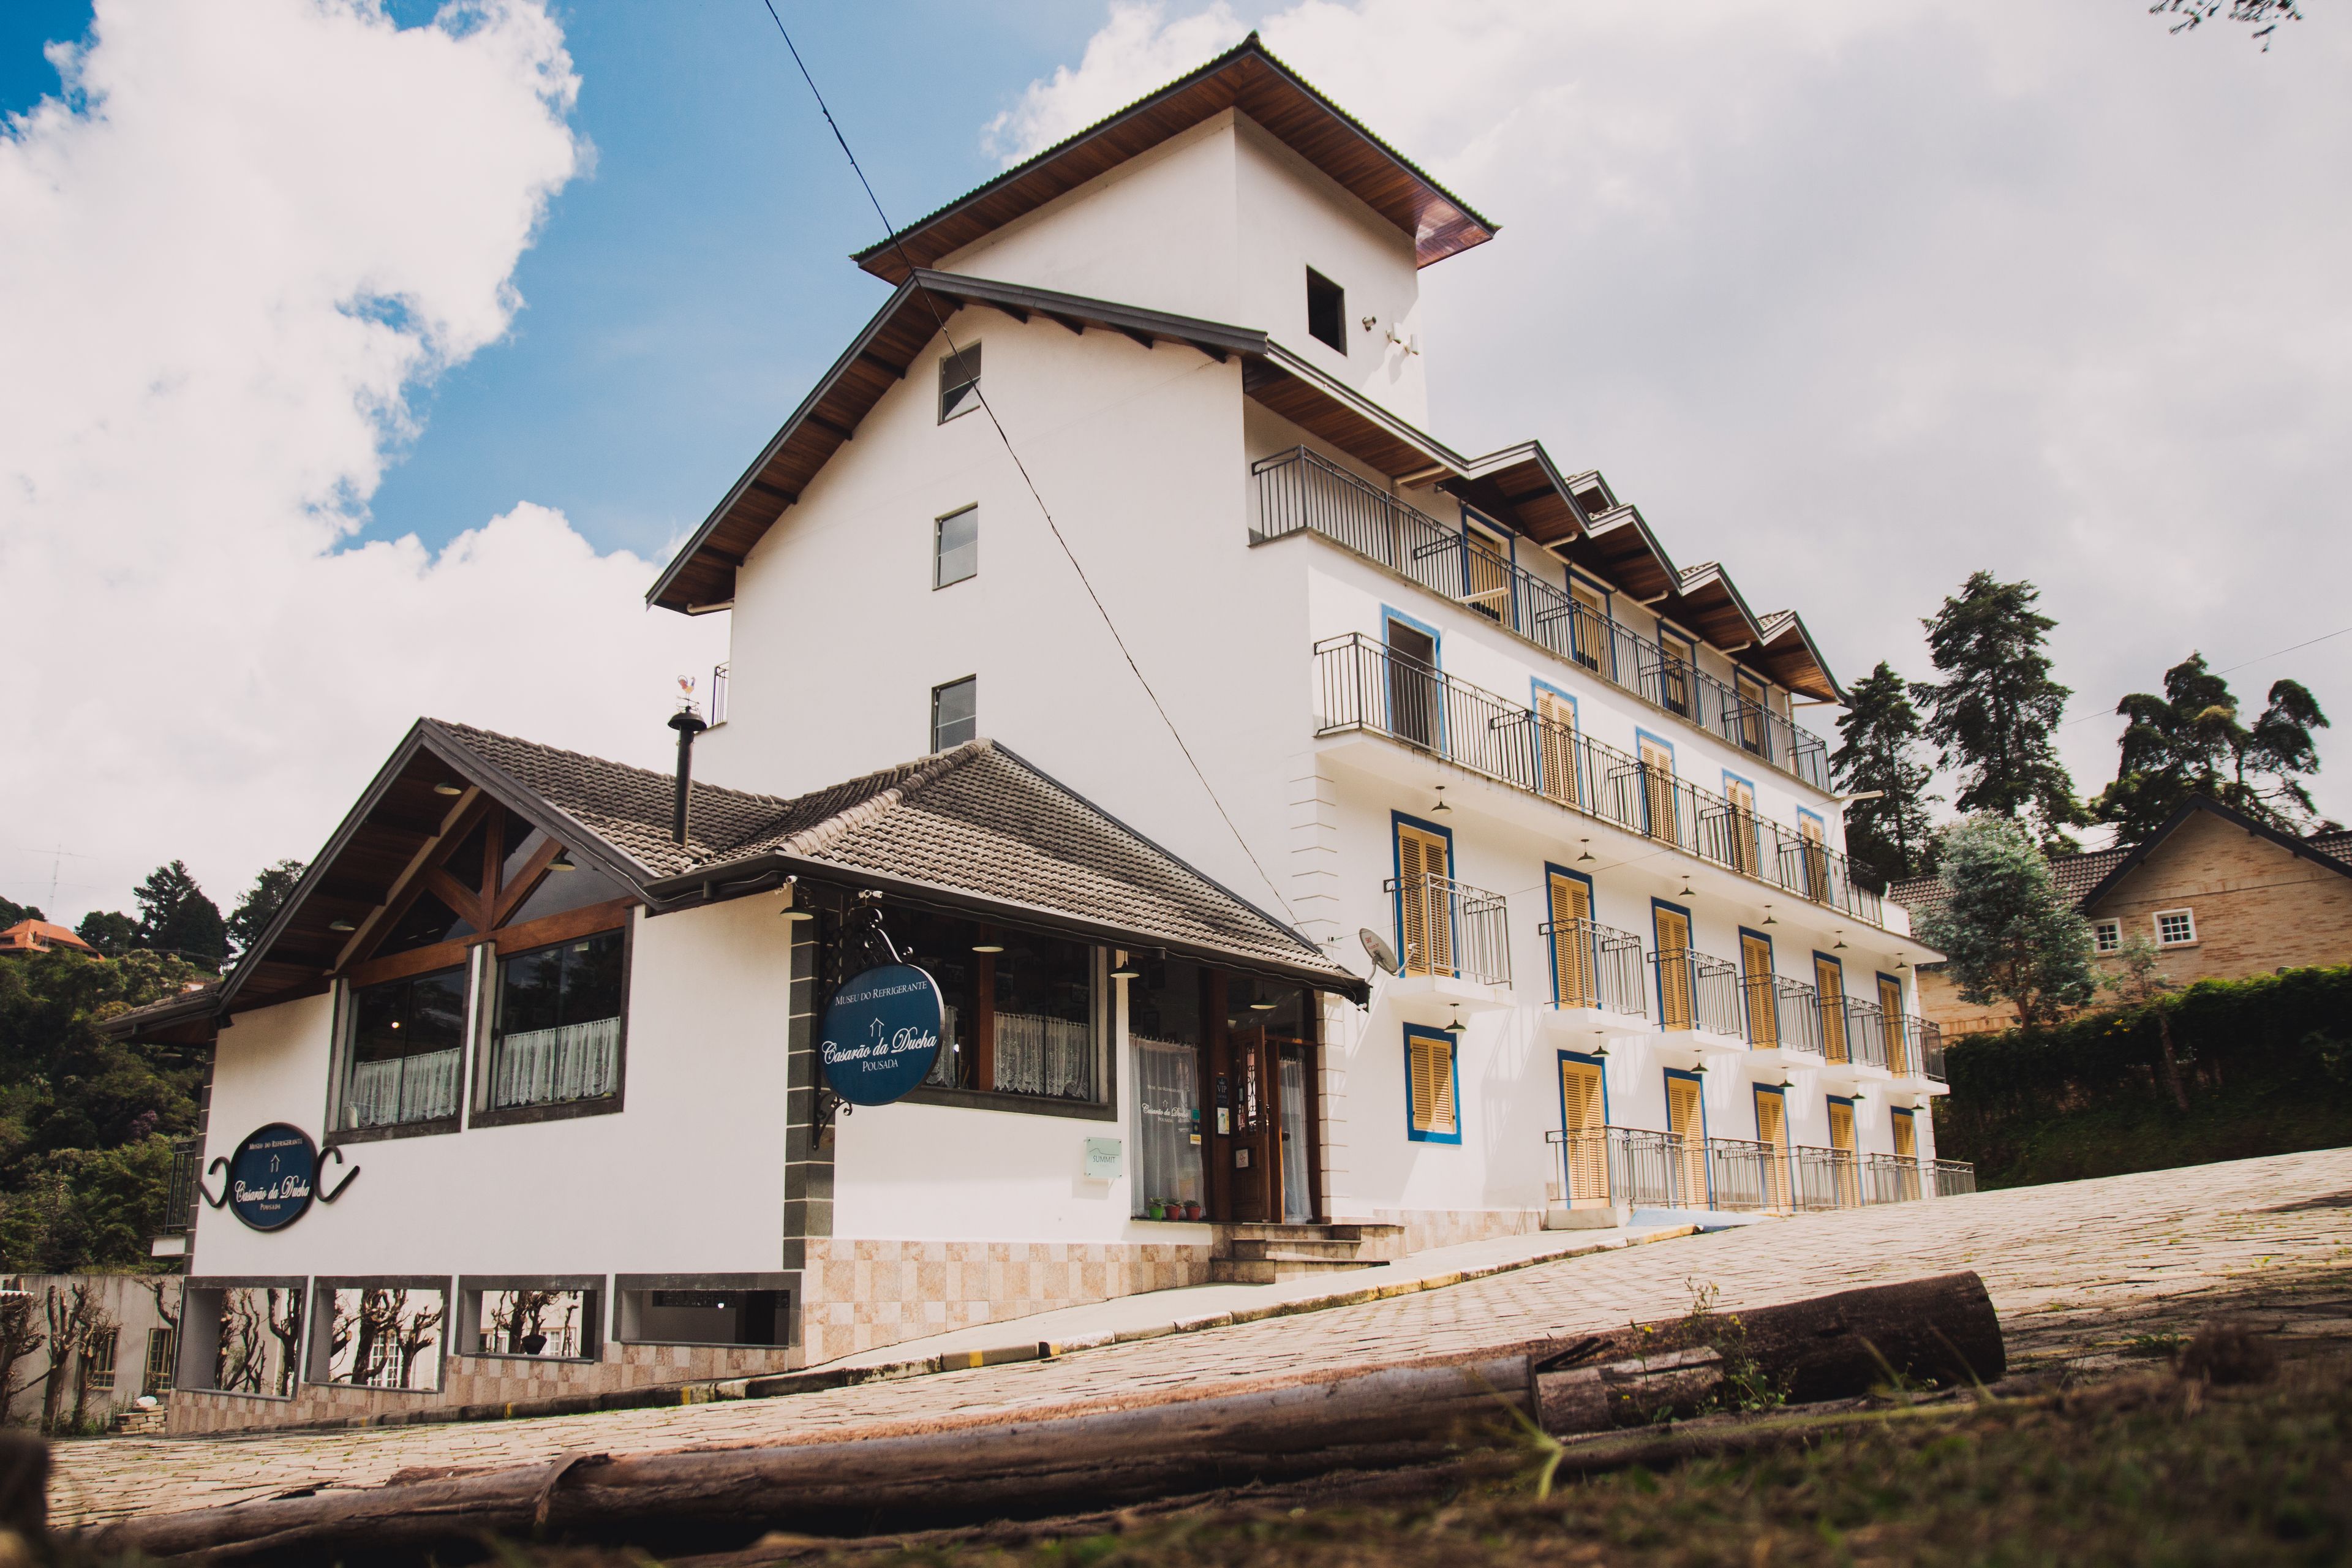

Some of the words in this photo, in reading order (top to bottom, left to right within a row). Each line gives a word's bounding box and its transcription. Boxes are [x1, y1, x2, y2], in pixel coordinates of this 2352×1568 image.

[835, 993, 860, 1006] MUSEU
[873, 981, 927, 999] REFRIGERANTE
[821, 1041, 871, 1065] Casarão
[873, 1037, 889, 1056] da
[891, 1027, 937, 1054] Ducha
[862, 1058, 899, 1072] POUSADA
[1217, 1085, 1227, 1093] VIP
[1142, 1102, 1164, 1115] Casarão
[235, 1180, 267, 1202] Casarão
[268, 1182, 279, 1199] da
[280, 1175, 311, 1199] Ducha
